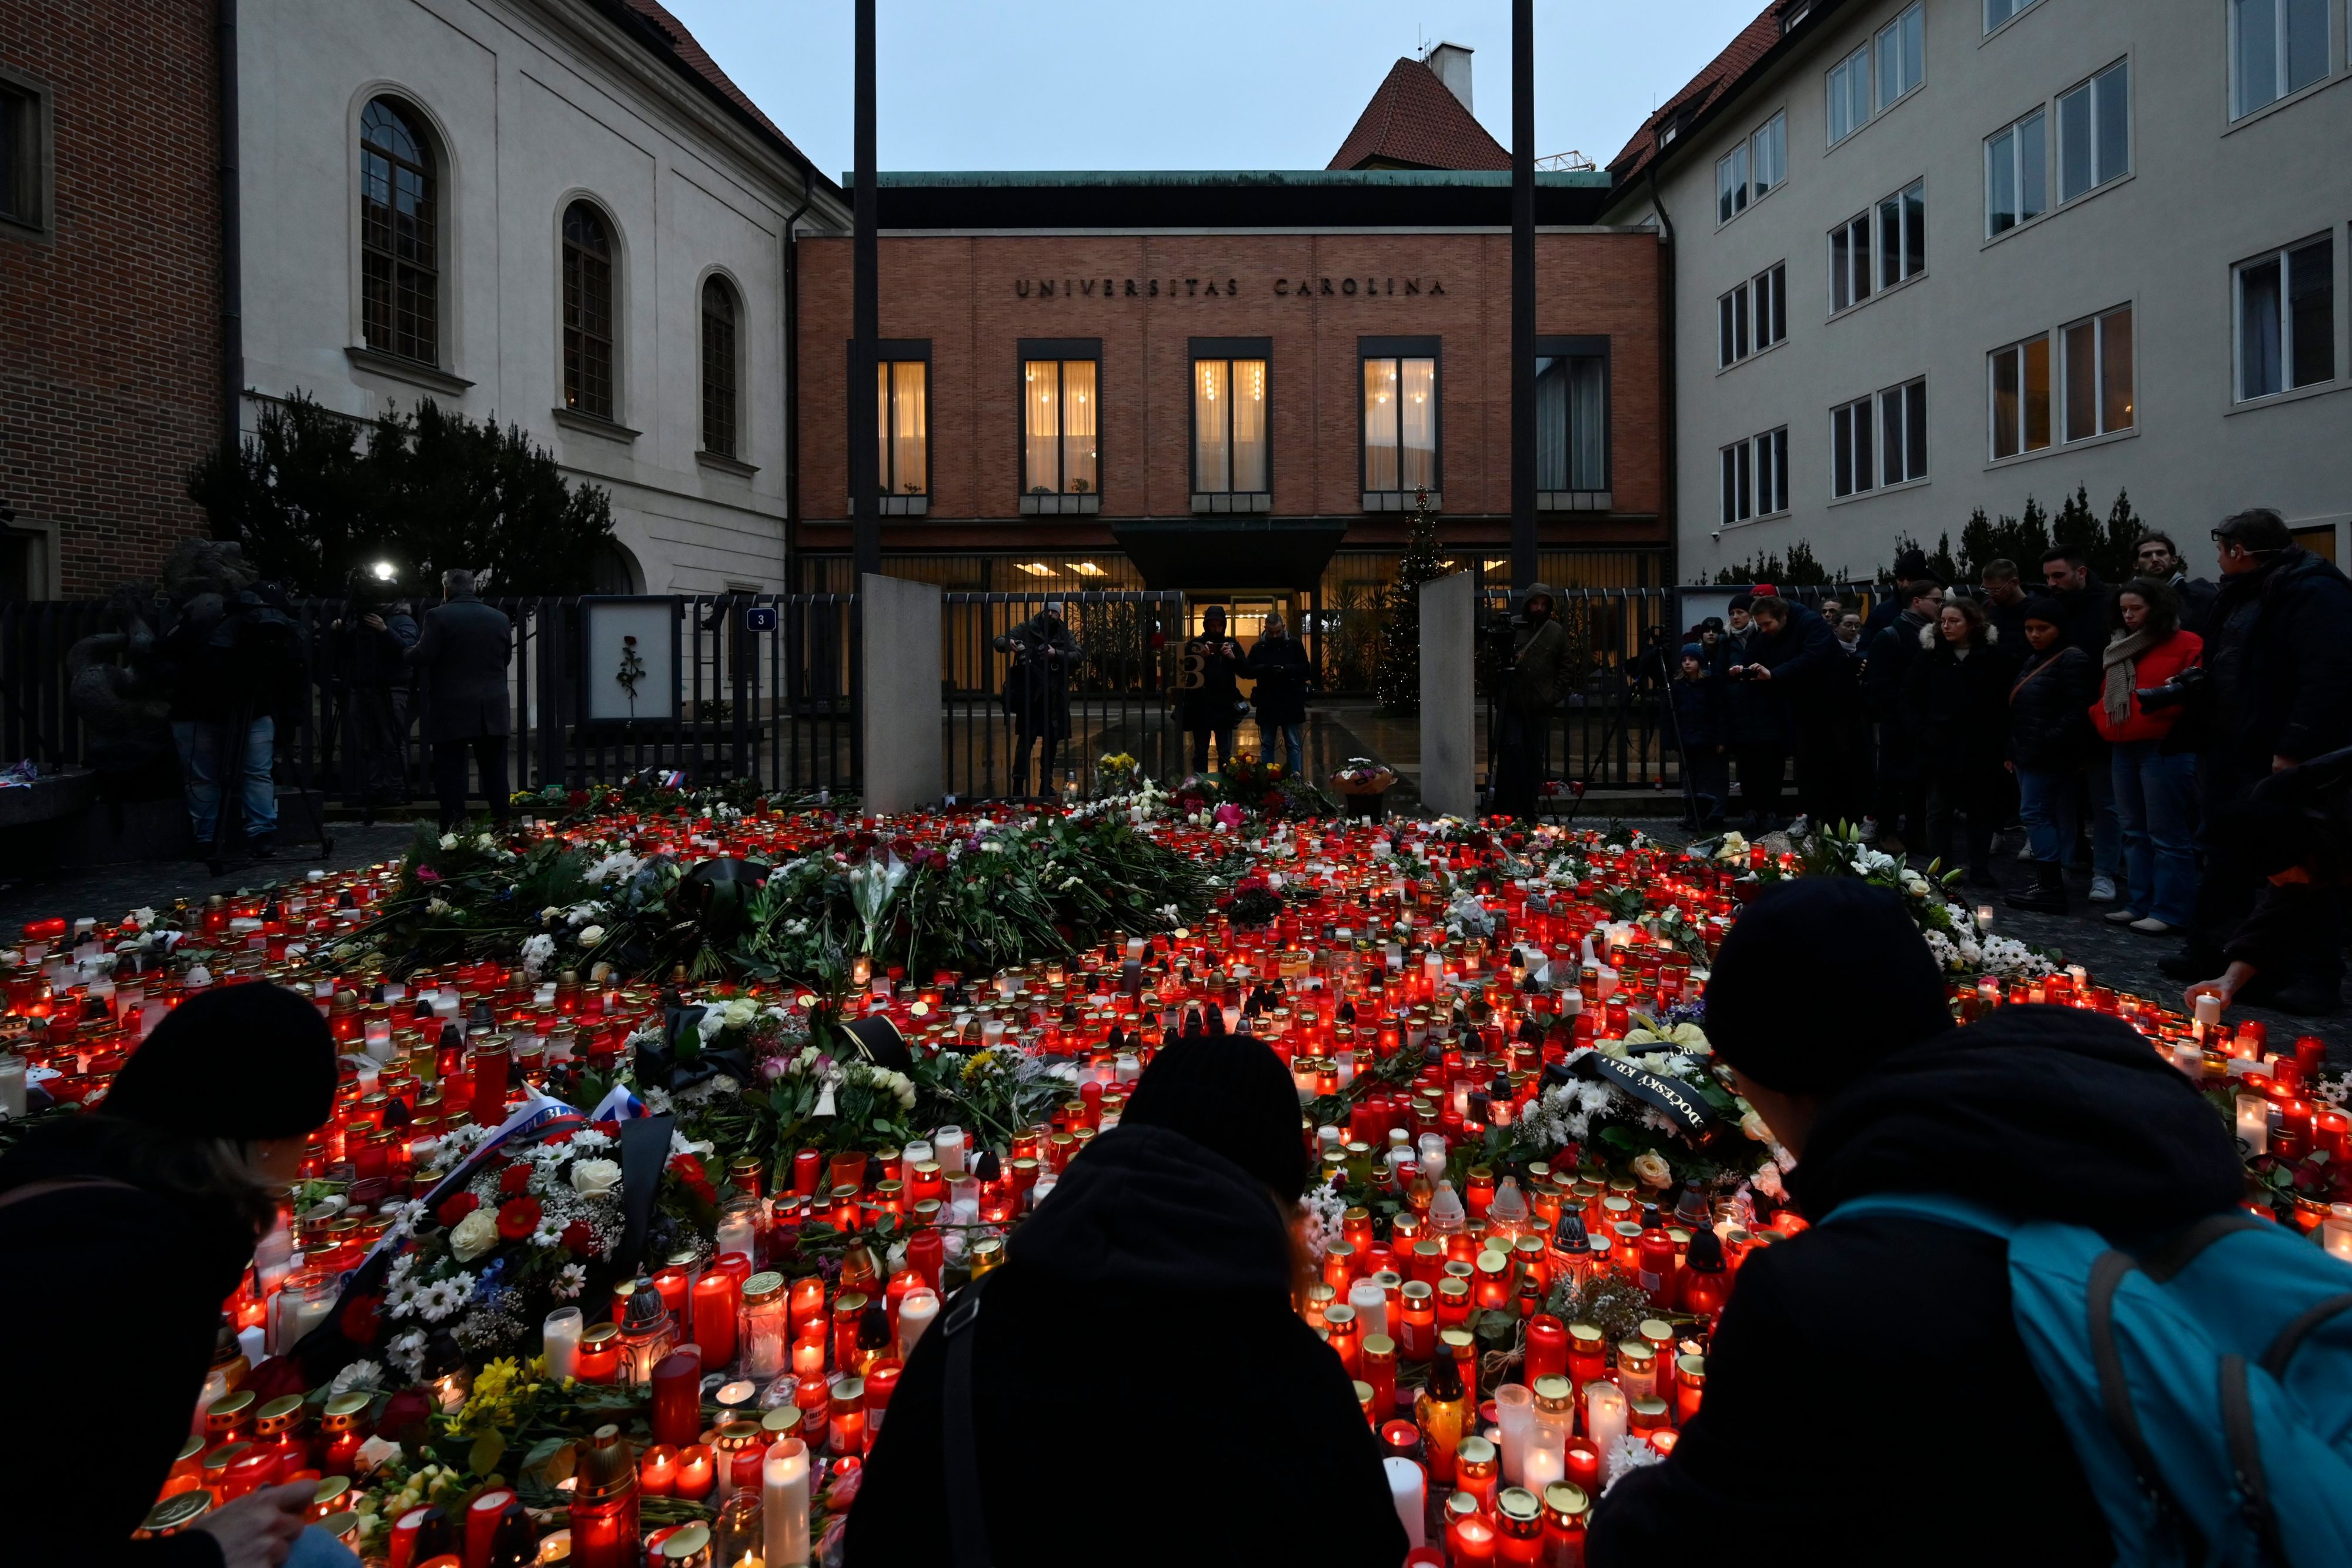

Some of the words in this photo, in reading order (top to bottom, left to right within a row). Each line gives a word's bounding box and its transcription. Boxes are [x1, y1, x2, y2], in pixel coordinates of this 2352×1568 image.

[1015, 278, 1238, 297] UNIVERSITAS
[1274, 278, 1445, 295] CAROLINA
[758, 614, 764, 624] 3
